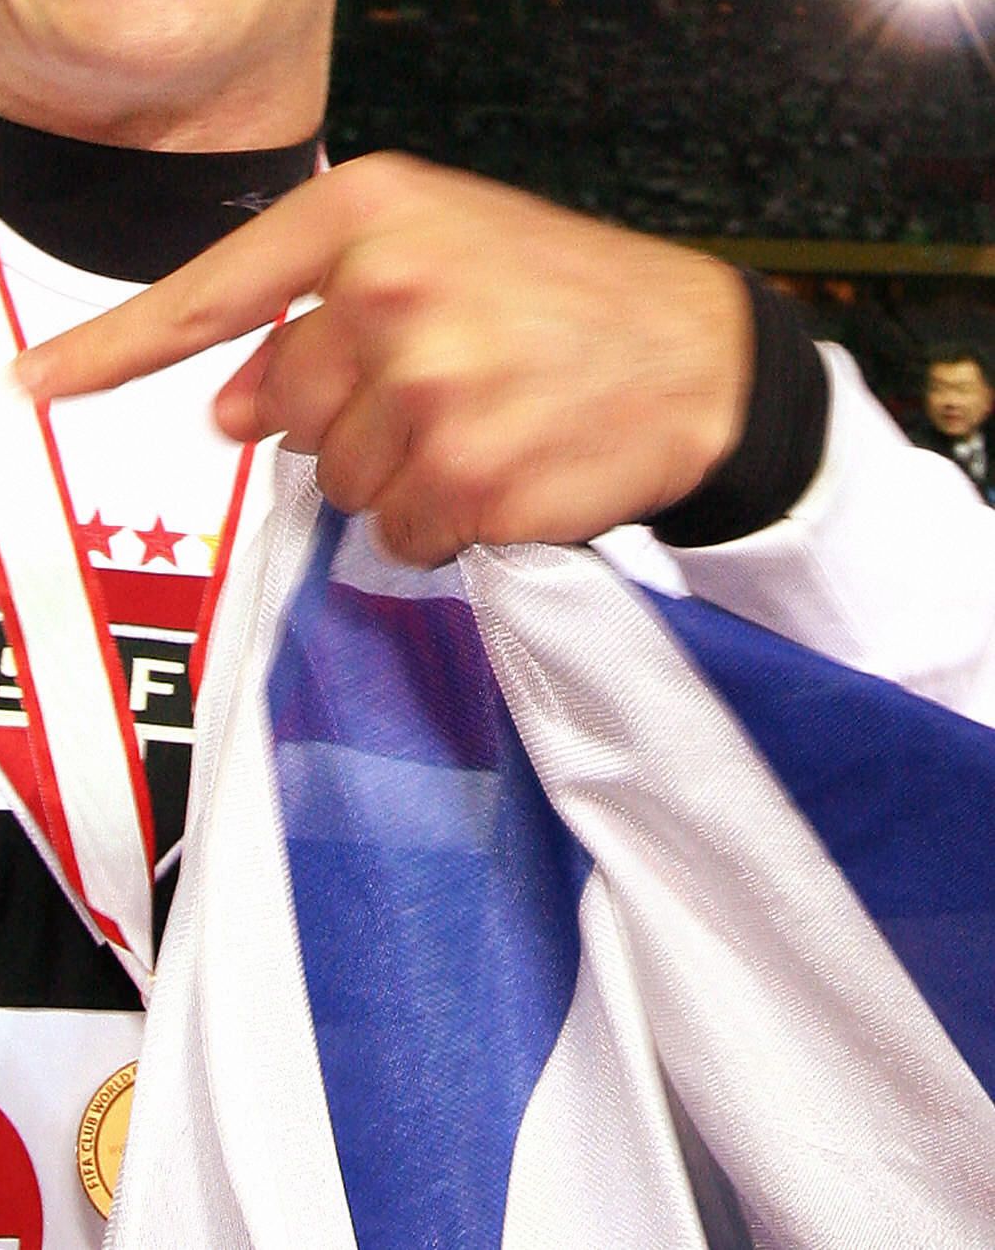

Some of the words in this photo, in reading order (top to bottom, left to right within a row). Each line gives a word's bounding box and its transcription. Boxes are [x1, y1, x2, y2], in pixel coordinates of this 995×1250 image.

[90, 1071, 131, 1115] WORLD
[80, 1116, 98, 1152] CLUB
[82, 1157, 100, 1190] FIFA
